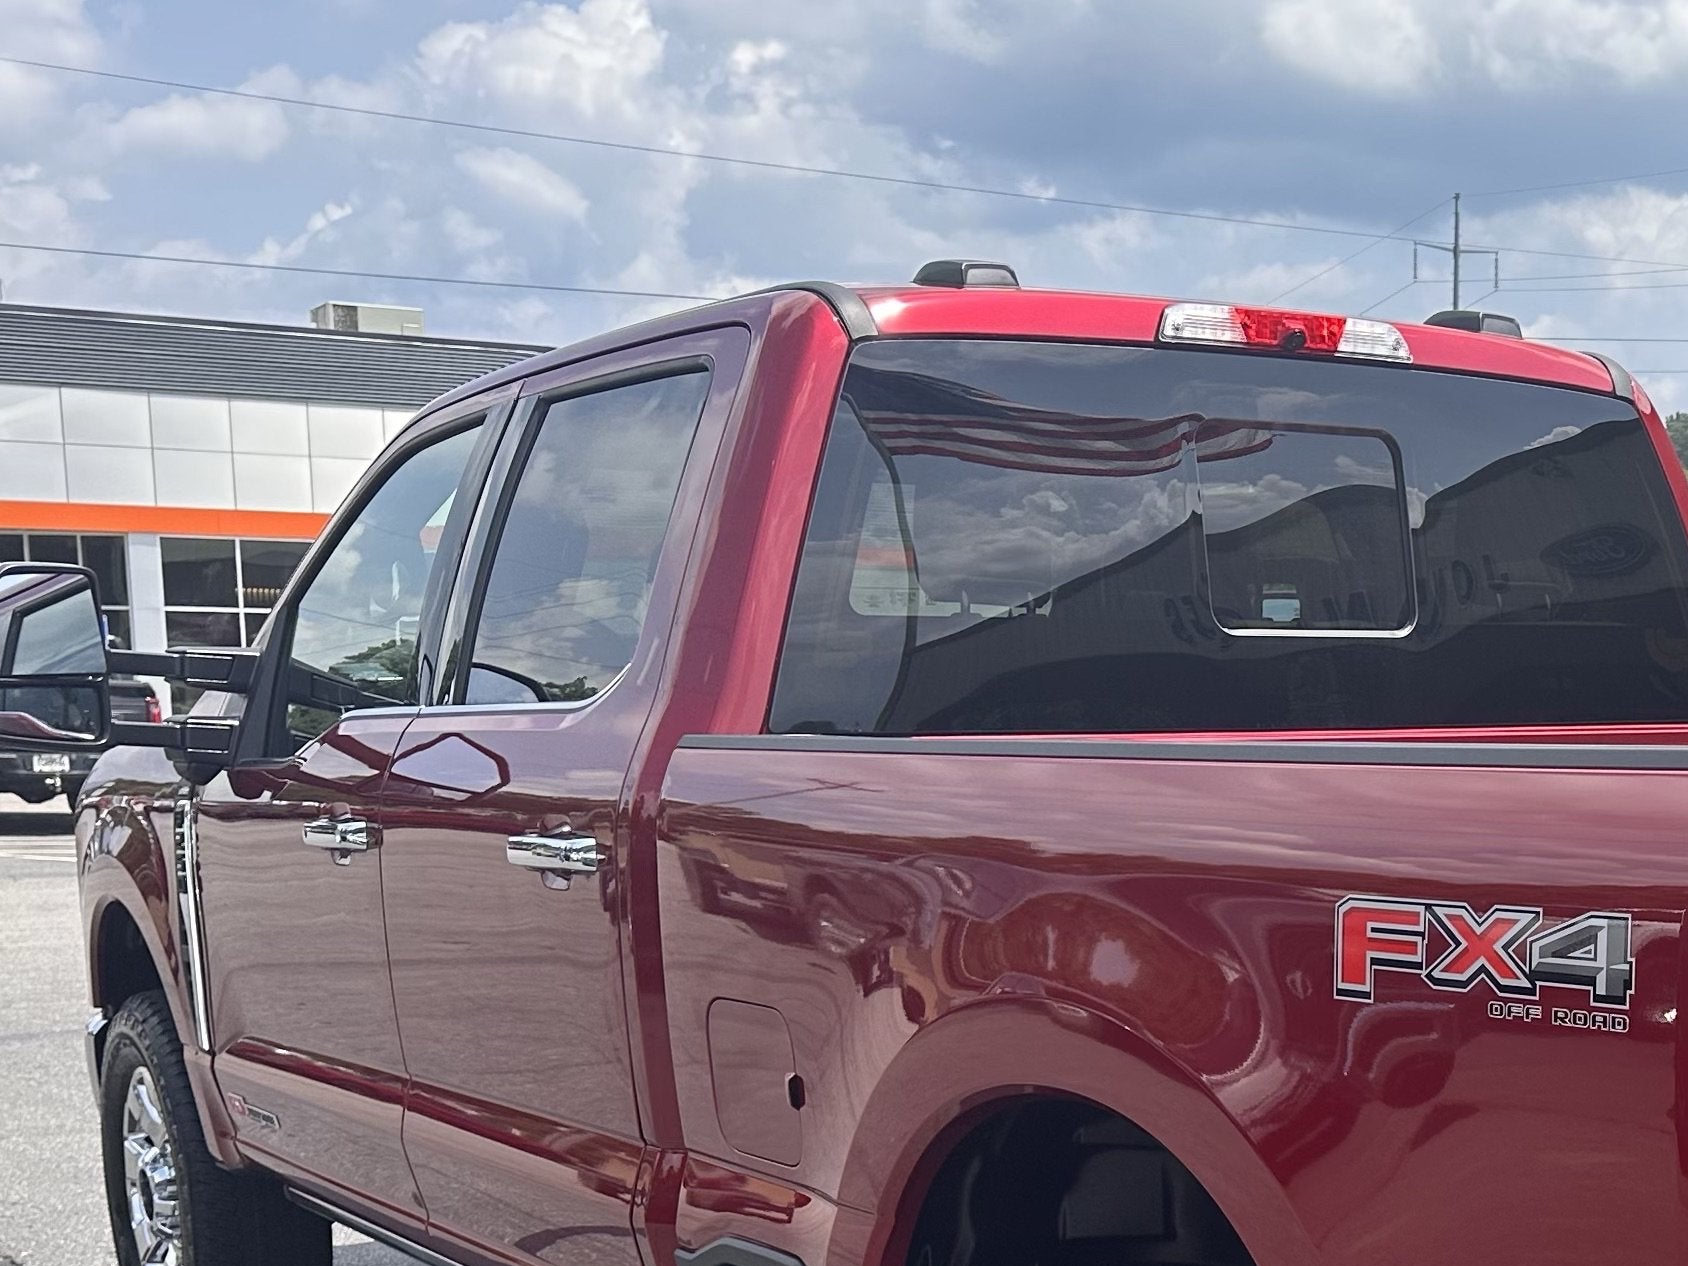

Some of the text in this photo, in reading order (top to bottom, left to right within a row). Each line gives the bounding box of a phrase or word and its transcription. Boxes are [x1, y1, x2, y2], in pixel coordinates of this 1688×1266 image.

[1334, 894, 1635, 1009] FX4
[1488, 1000, 1630, 1033] OFF ROAD
